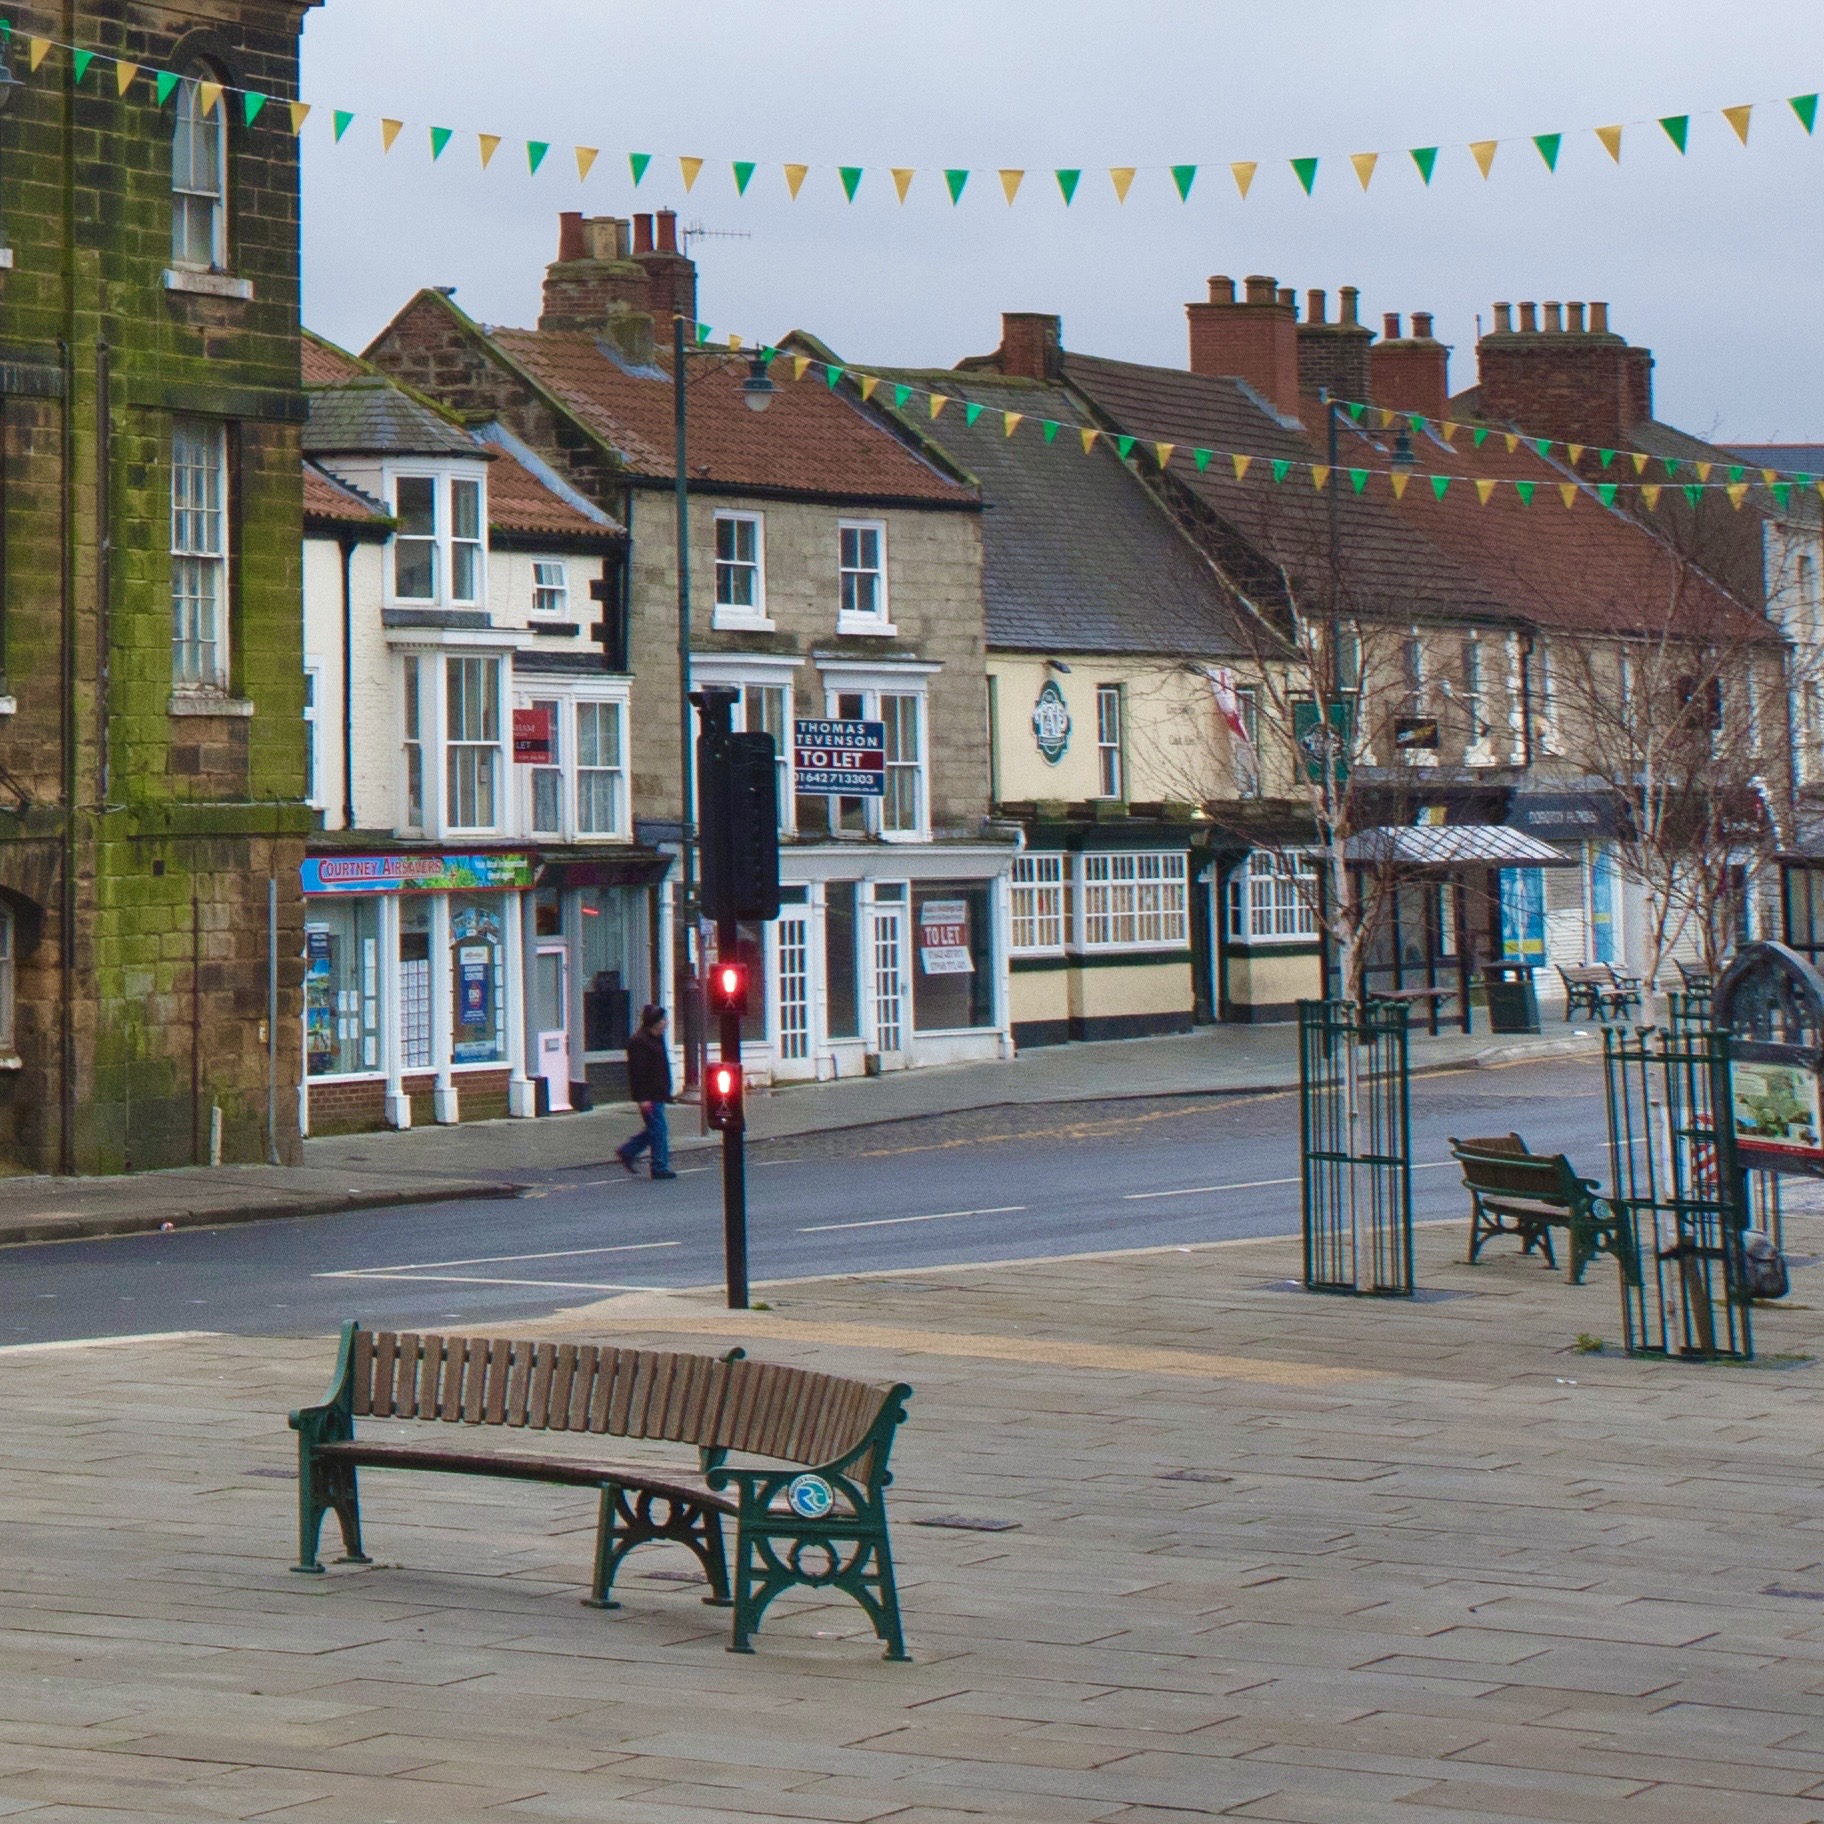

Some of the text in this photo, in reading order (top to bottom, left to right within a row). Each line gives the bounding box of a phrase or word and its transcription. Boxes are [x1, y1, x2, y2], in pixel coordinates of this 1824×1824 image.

[798, 722, 866, 735] THOMAS
[796, 734, 879, 747] TEVENSON
[800, 751, 863, 768] TO LET
[320, 860, 378, 879] COURTNEY
[925, 926, 960, 945] TO LET
